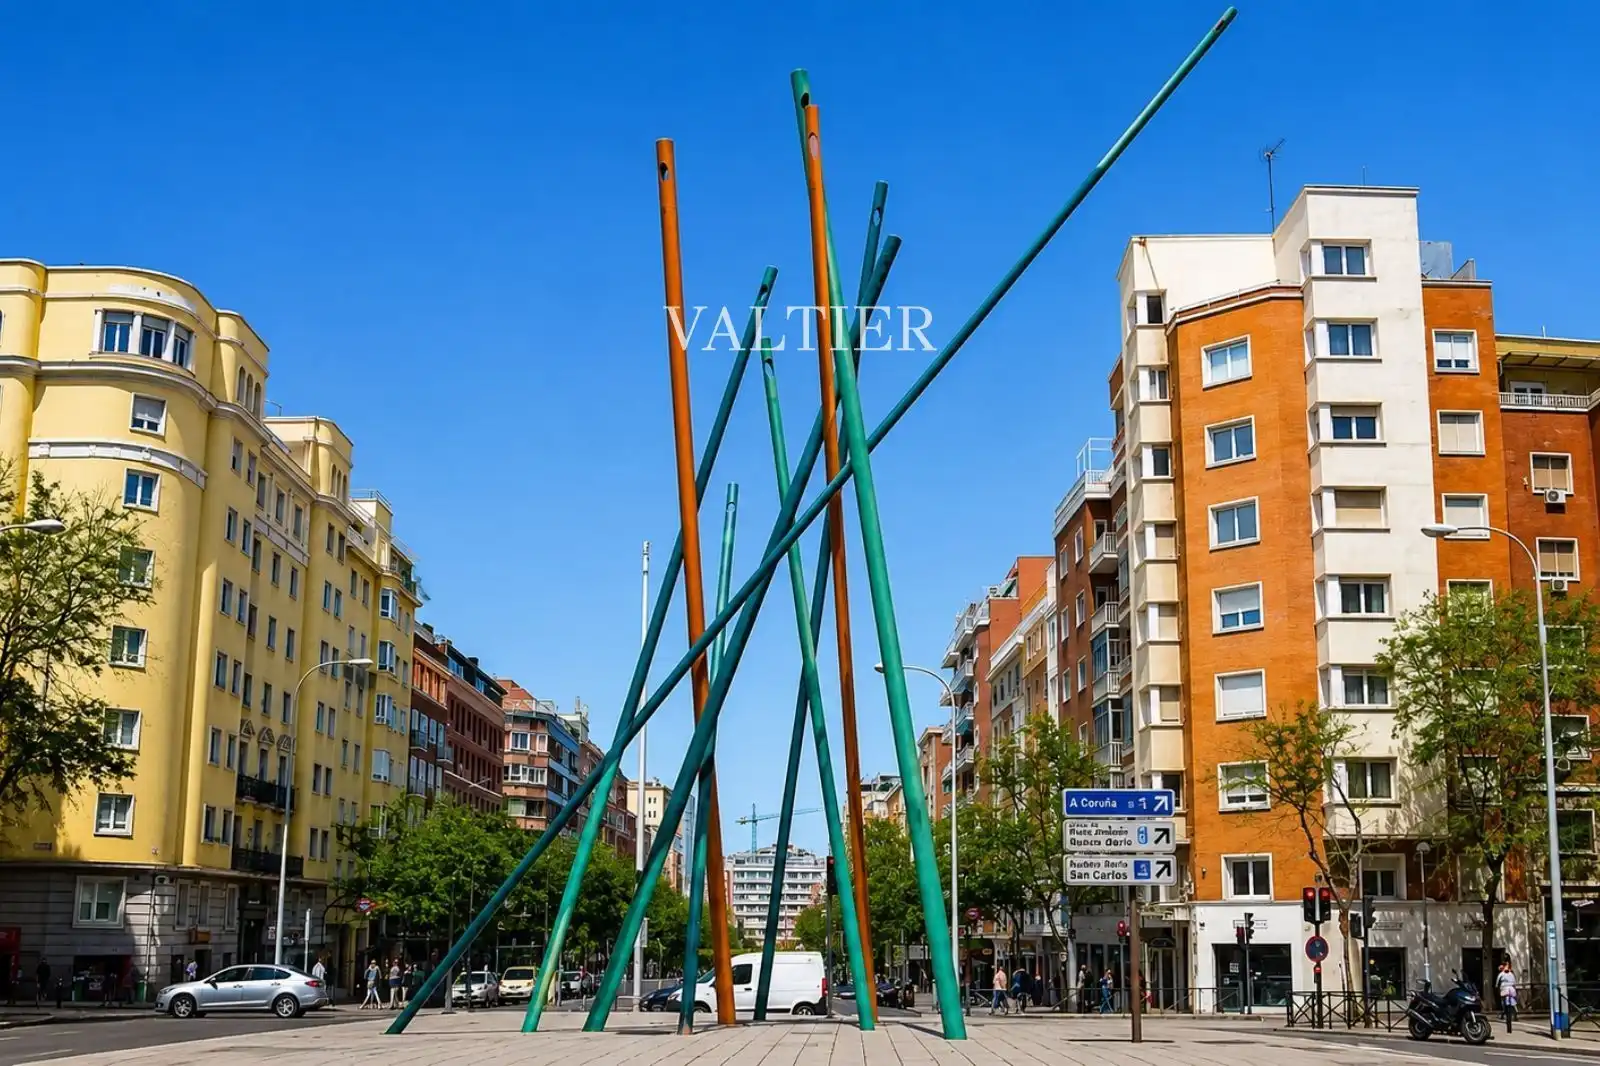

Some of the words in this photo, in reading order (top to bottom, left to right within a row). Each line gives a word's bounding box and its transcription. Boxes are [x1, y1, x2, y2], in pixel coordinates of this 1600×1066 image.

[1069, 797, 1078, 808] A
[1070, 870, 1090, 880] San
[1093, 870, 1128, 880] Carlos
